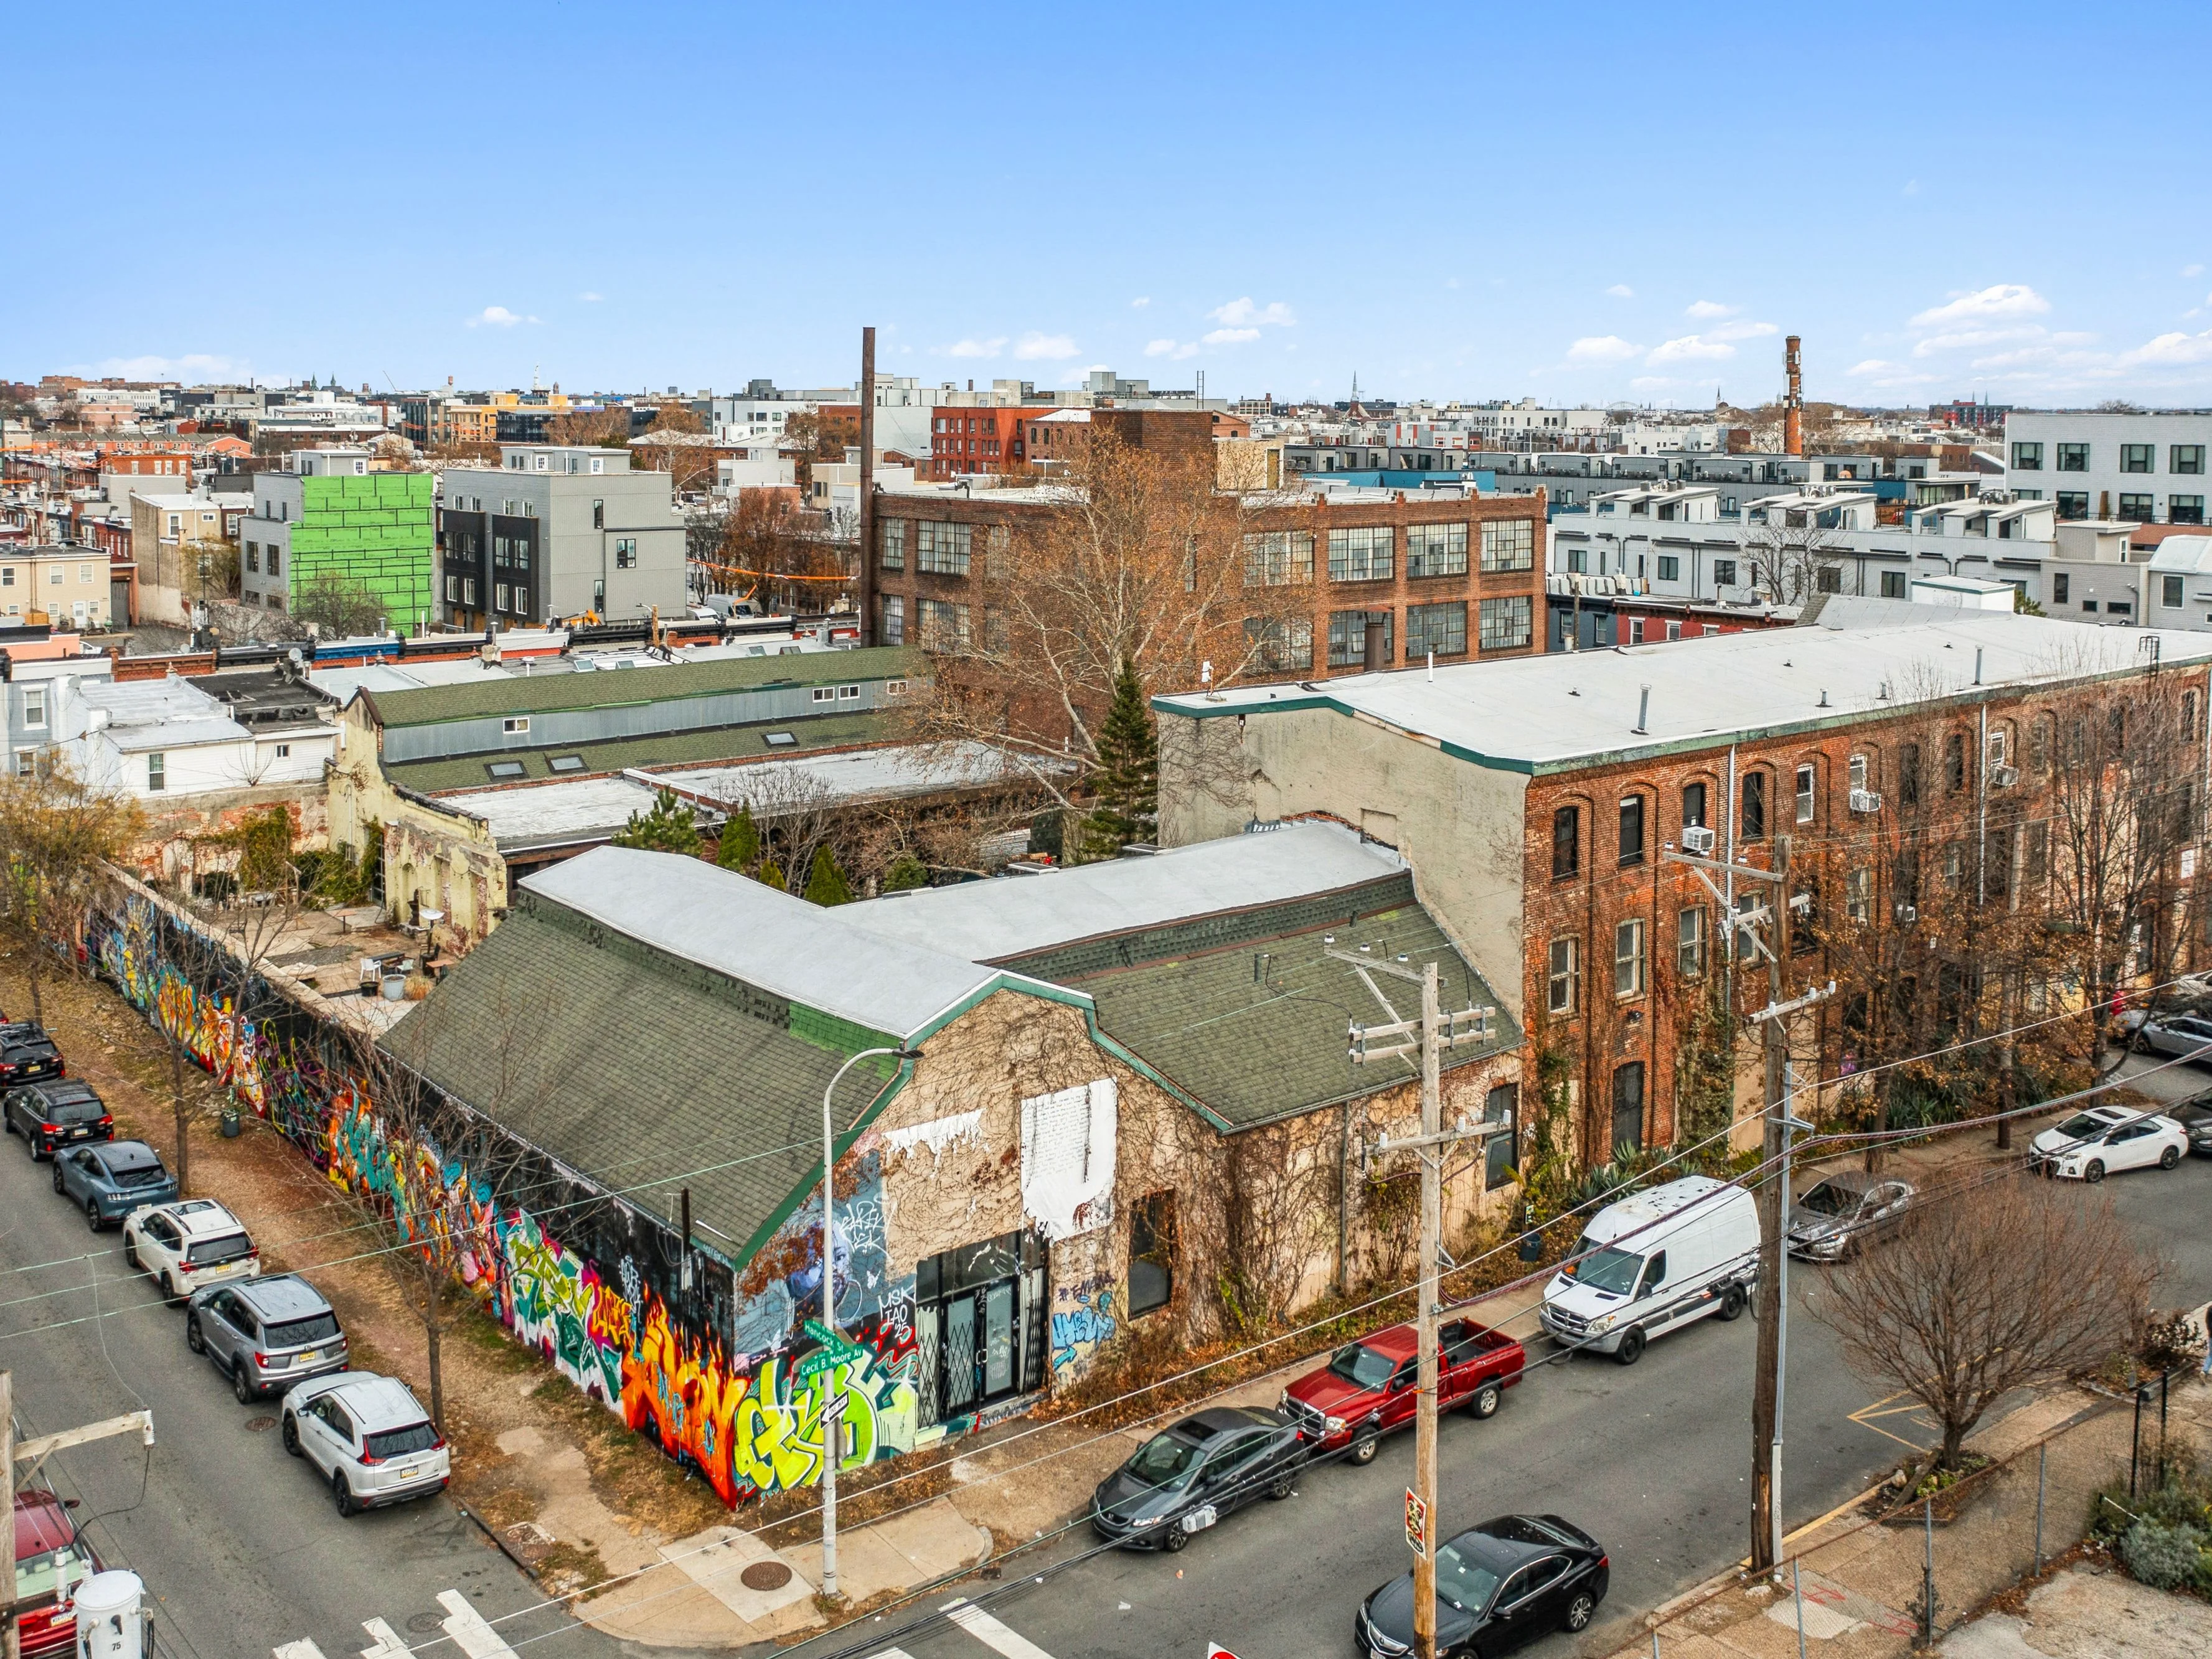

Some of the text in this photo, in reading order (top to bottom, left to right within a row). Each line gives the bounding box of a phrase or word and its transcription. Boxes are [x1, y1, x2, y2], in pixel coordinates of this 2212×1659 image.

[804, 1322, 834, 1347] Hancock
[837, 1342, 844, 1353] St
[801, 1361, 819, 1376] Cecil
[821, 1358, 827, 1368] B.
[830, 1351, 851, 1366] Moore
[854, 1349, 862, 1358] Av
[838, 1398, 846, 1409] WAY
[112, 1642, 121, 1651] 75
